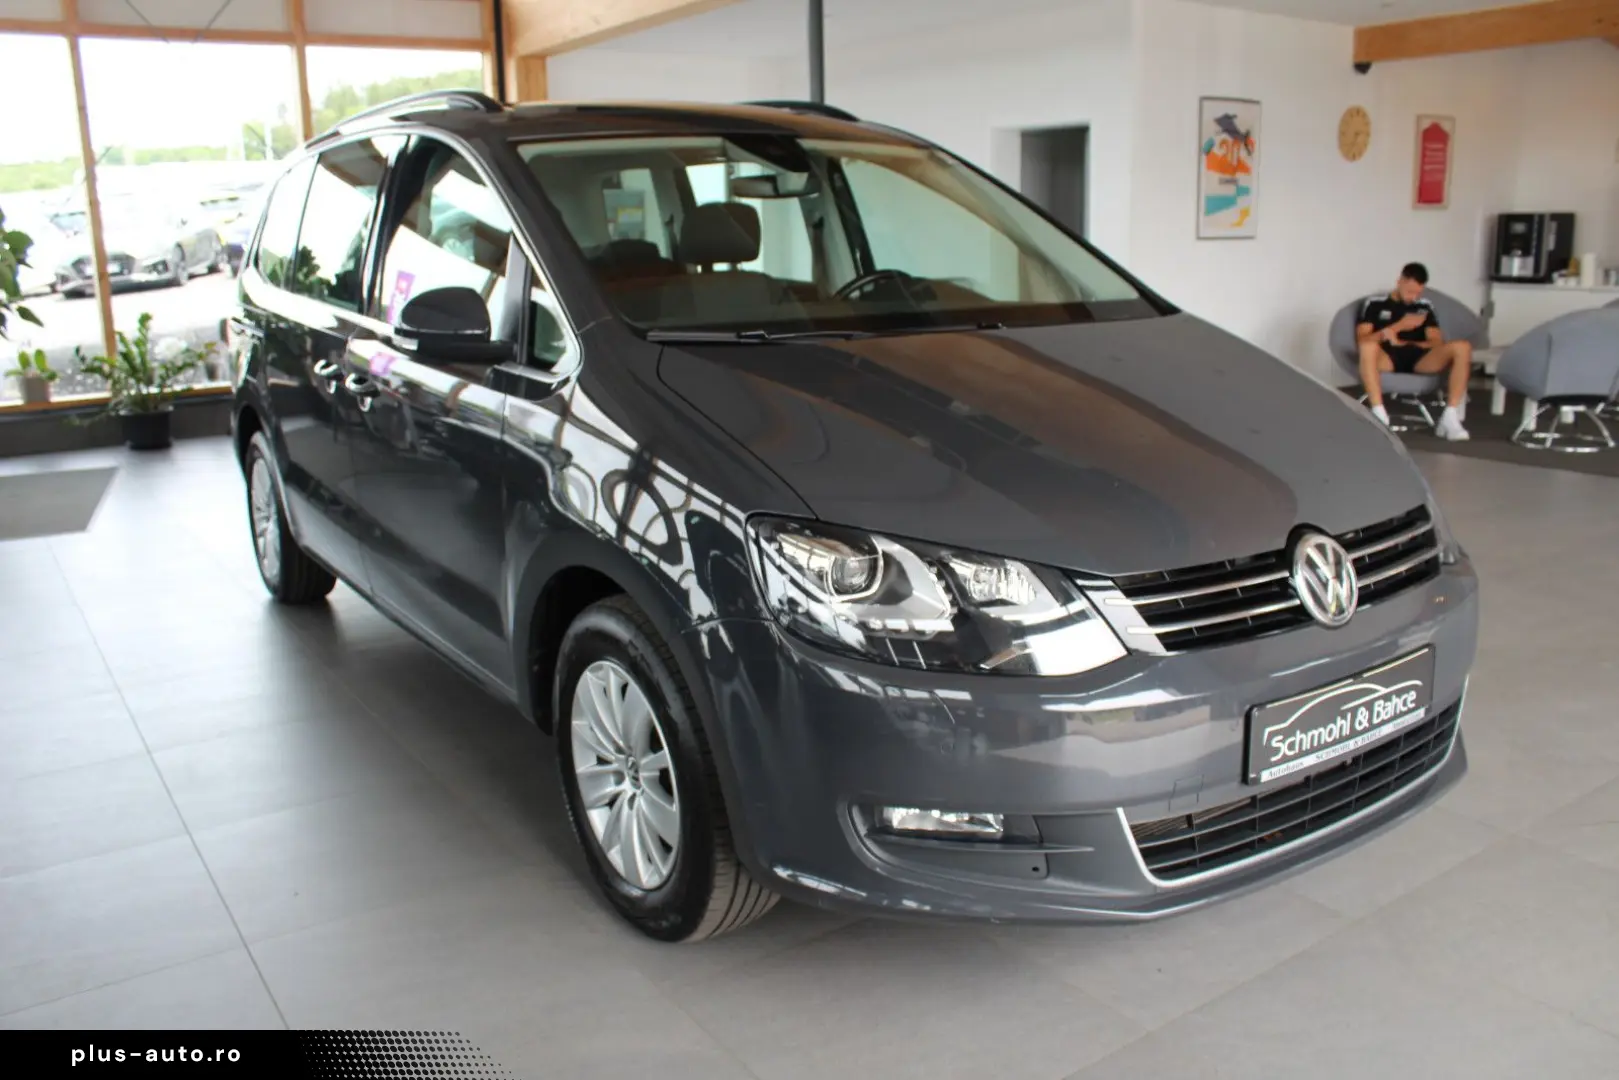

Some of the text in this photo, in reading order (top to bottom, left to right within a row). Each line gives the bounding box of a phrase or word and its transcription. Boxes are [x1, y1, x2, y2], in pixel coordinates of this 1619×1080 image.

[1270, 711, 1351, 762] Schmohl
[1354, 706, 1369, 731] &
[1372, 690, 1417, 725] Bahce
[1268, 761, 1304, 779] Autohaus
